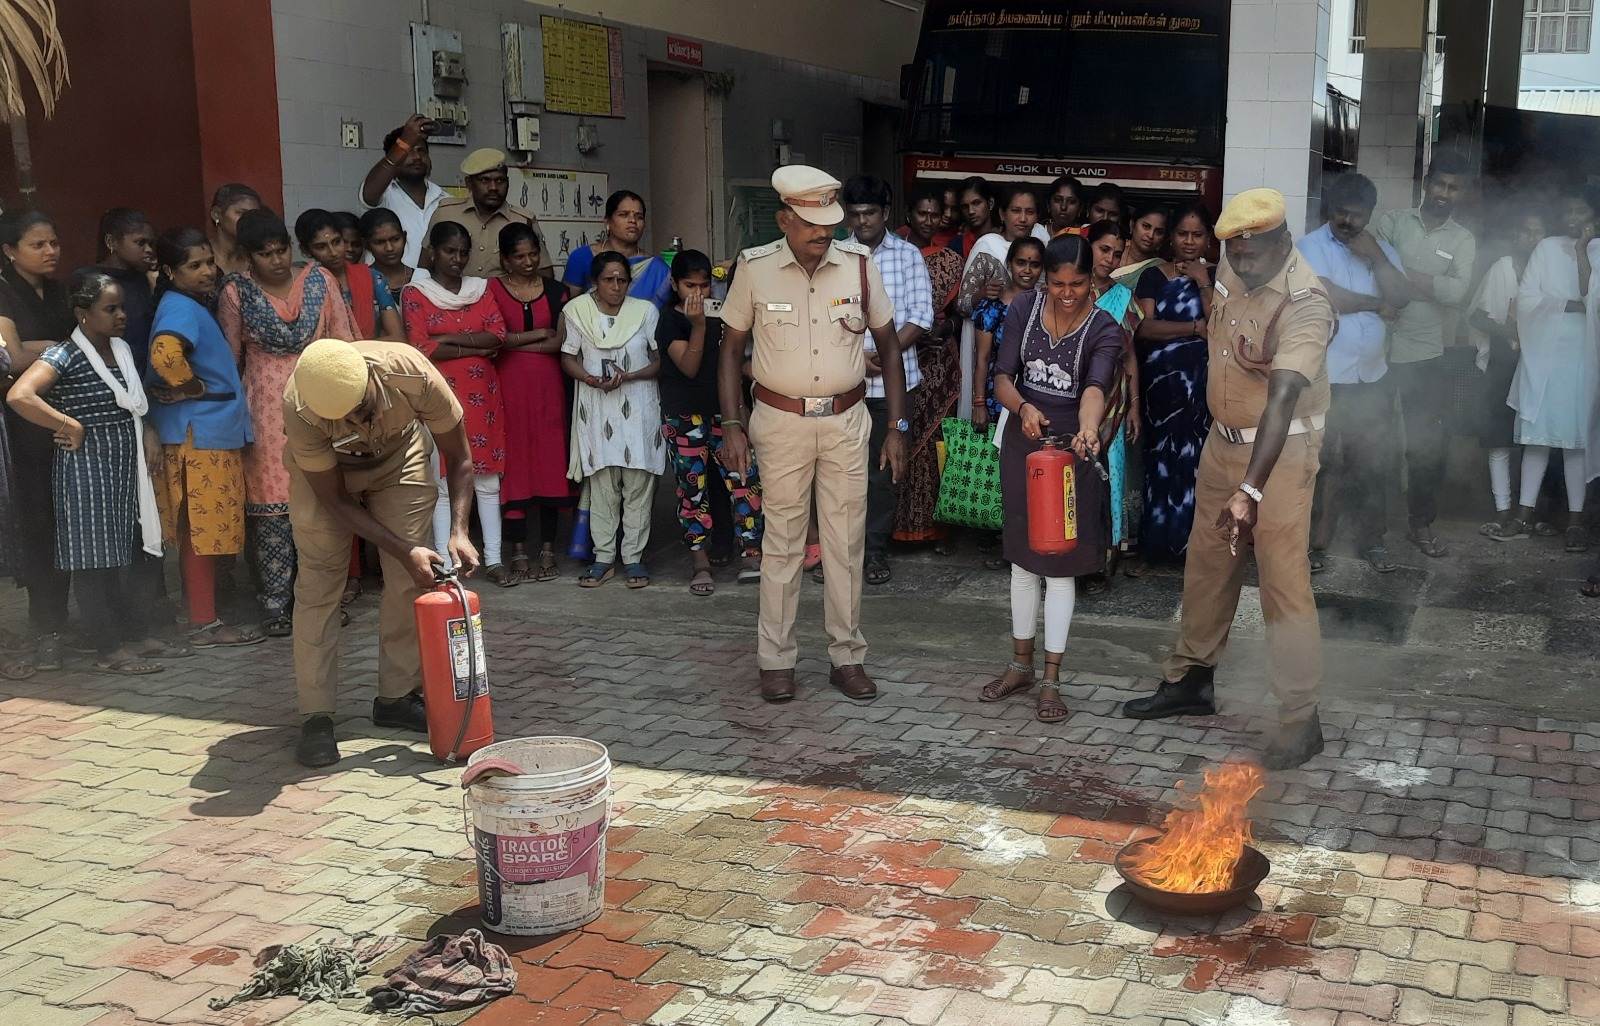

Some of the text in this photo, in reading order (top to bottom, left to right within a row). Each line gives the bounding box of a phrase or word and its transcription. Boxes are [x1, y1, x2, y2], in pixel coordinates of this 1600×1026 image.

[947, 10, 996, 27] தமிழ்நாடு
[996, 9, 1052, 26] தீயணைப்பு
[1053, 9, 1092, 28] ம்றும்
[1168, 16, 1201, 31] துறை
[996, 163, 1107, 177] ASHOK LEYLAND
[1159, 169, 1197, 181] FIRE
[501, 838, 567, 853] TRACTOR
[502, 851, 568, 864] SPARC
[503, 863, 569, 874] ECONOMY EMULSION
